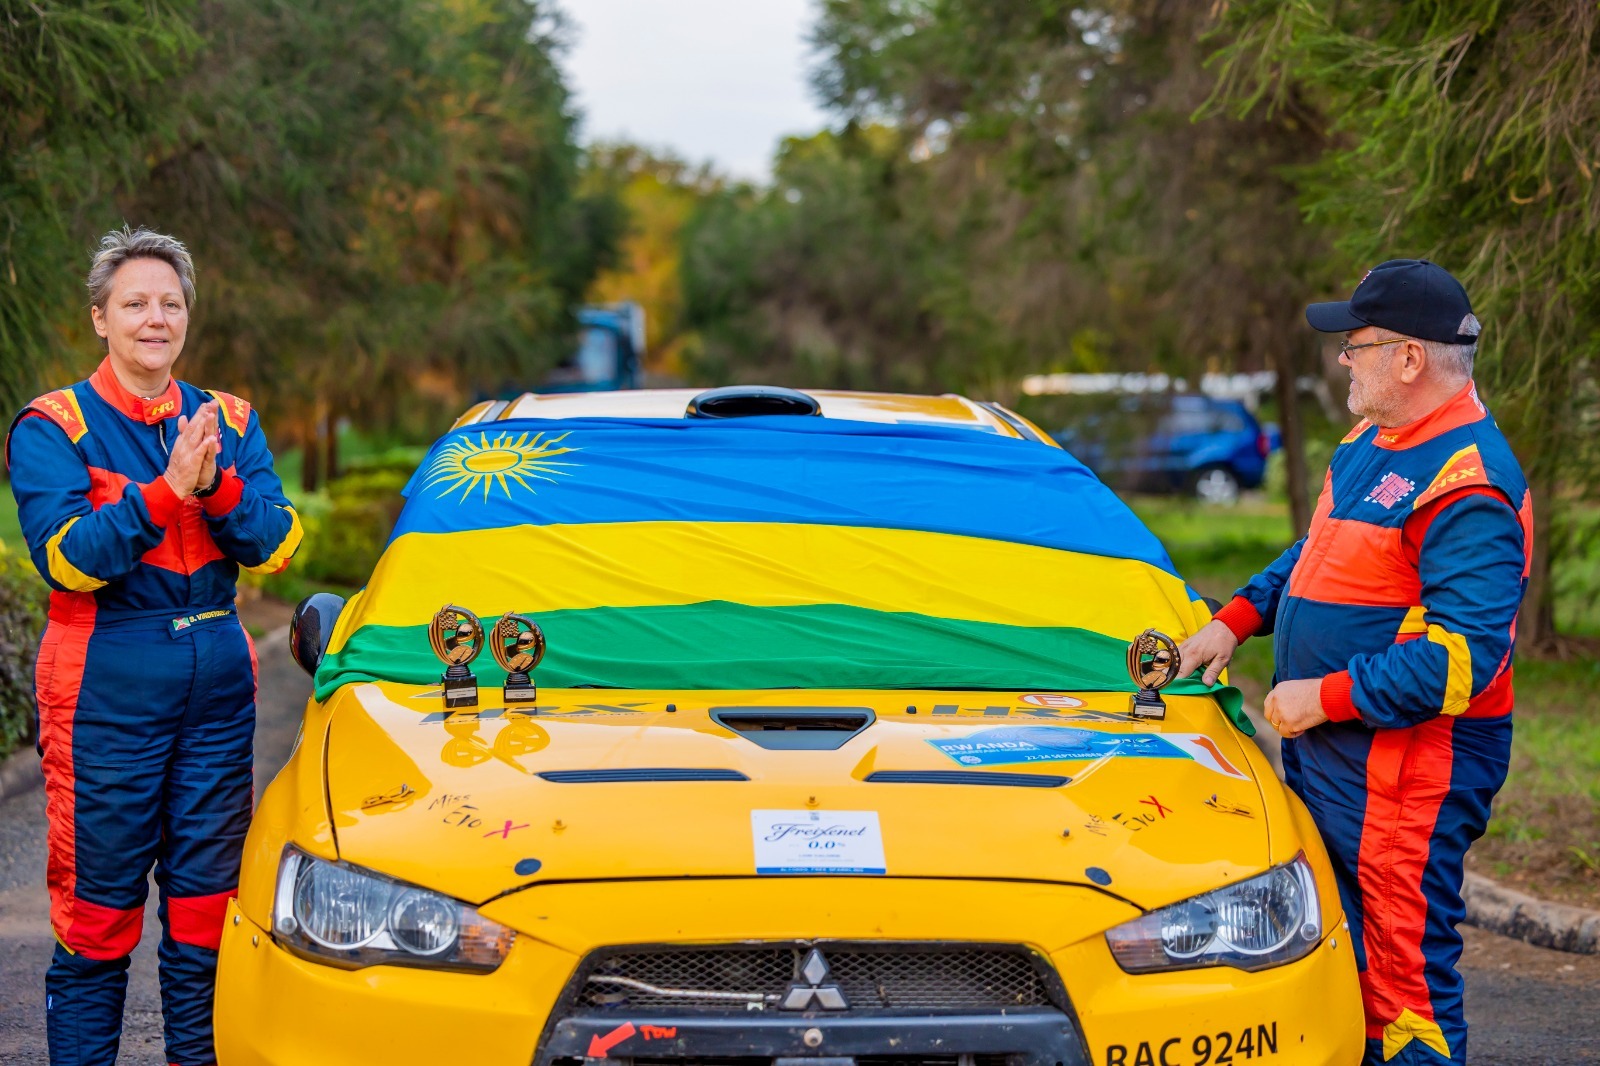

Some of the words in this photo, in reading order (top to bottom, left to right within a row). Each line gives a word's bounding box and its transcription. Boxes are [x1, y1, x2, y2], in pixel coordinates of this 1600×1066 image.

[37, 397, 76, 422] HRX
[234, 396, 245, 418] HR
[1430, 467, 1478, 495] HRX
[940, 740, 1035, 752] RWANDA
[763, 822, 867, 842] Freixenet
[1106, 1037, 1182, 1066] RAC
[1192, 1021, 1278, 1066] 924N
